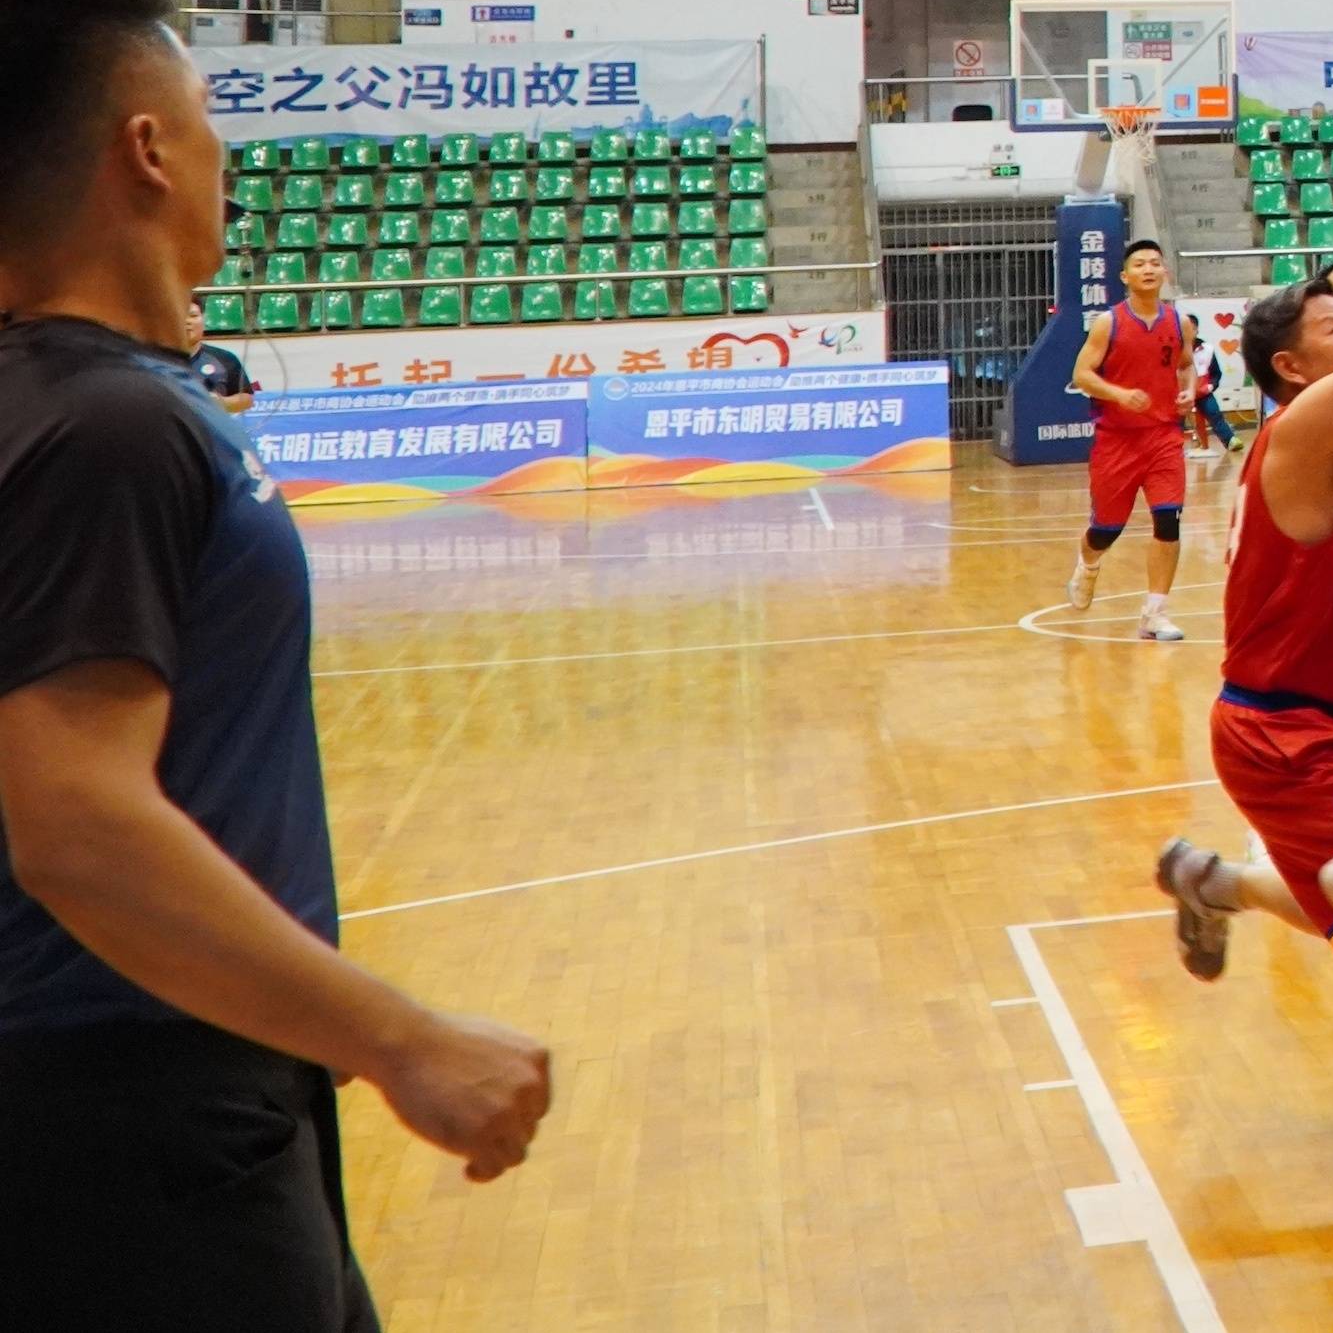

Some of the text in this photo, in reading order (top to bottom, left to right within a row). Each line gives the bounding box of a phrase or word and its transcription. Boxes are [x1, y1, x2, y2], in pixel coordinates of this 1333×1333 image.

[206, 61, 640, 114] 空之父冯如故里
[643, 397, 905, 439] 恩平市东明贸易有限公司
